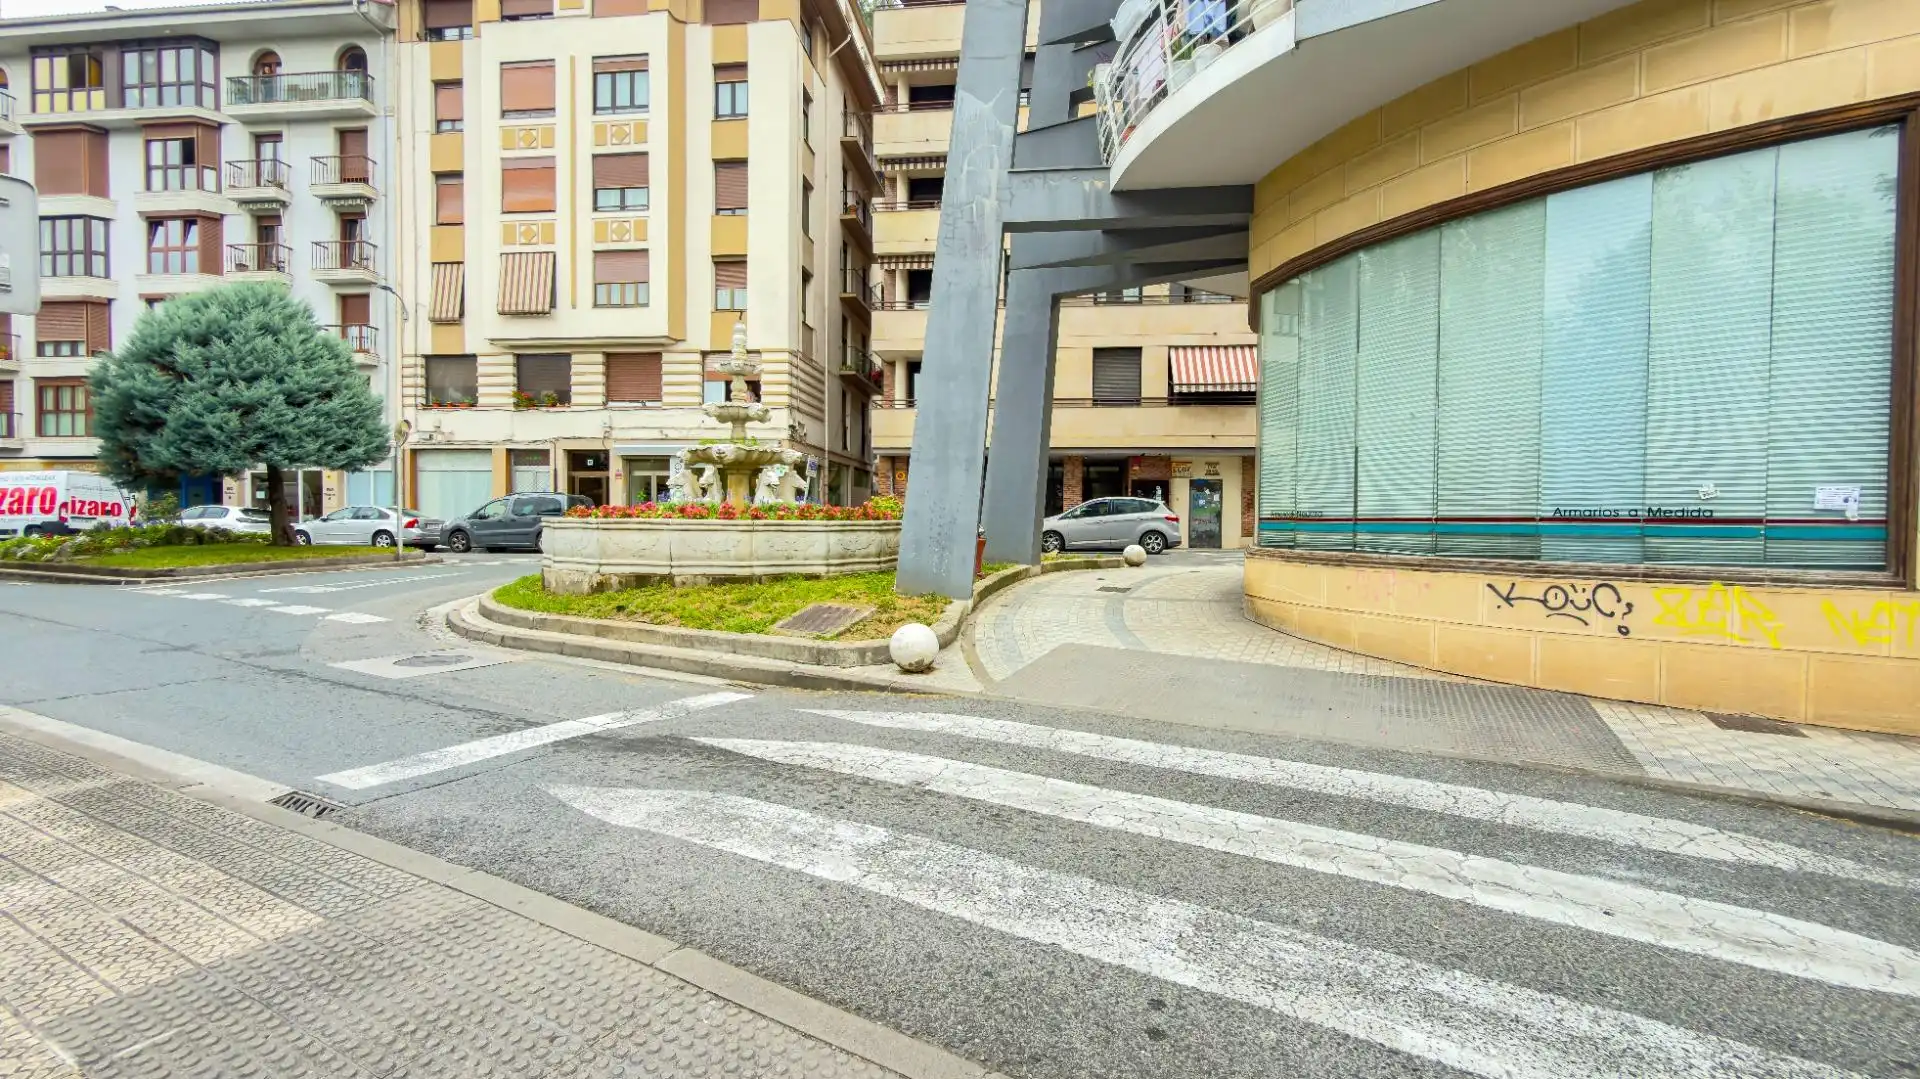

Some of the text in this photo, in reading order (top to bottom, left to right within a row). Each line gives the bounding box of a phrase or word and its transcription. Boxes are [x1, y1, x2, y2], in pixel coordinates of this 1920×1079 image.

[1552, 507, 1714, 518] Armarios a Medida
